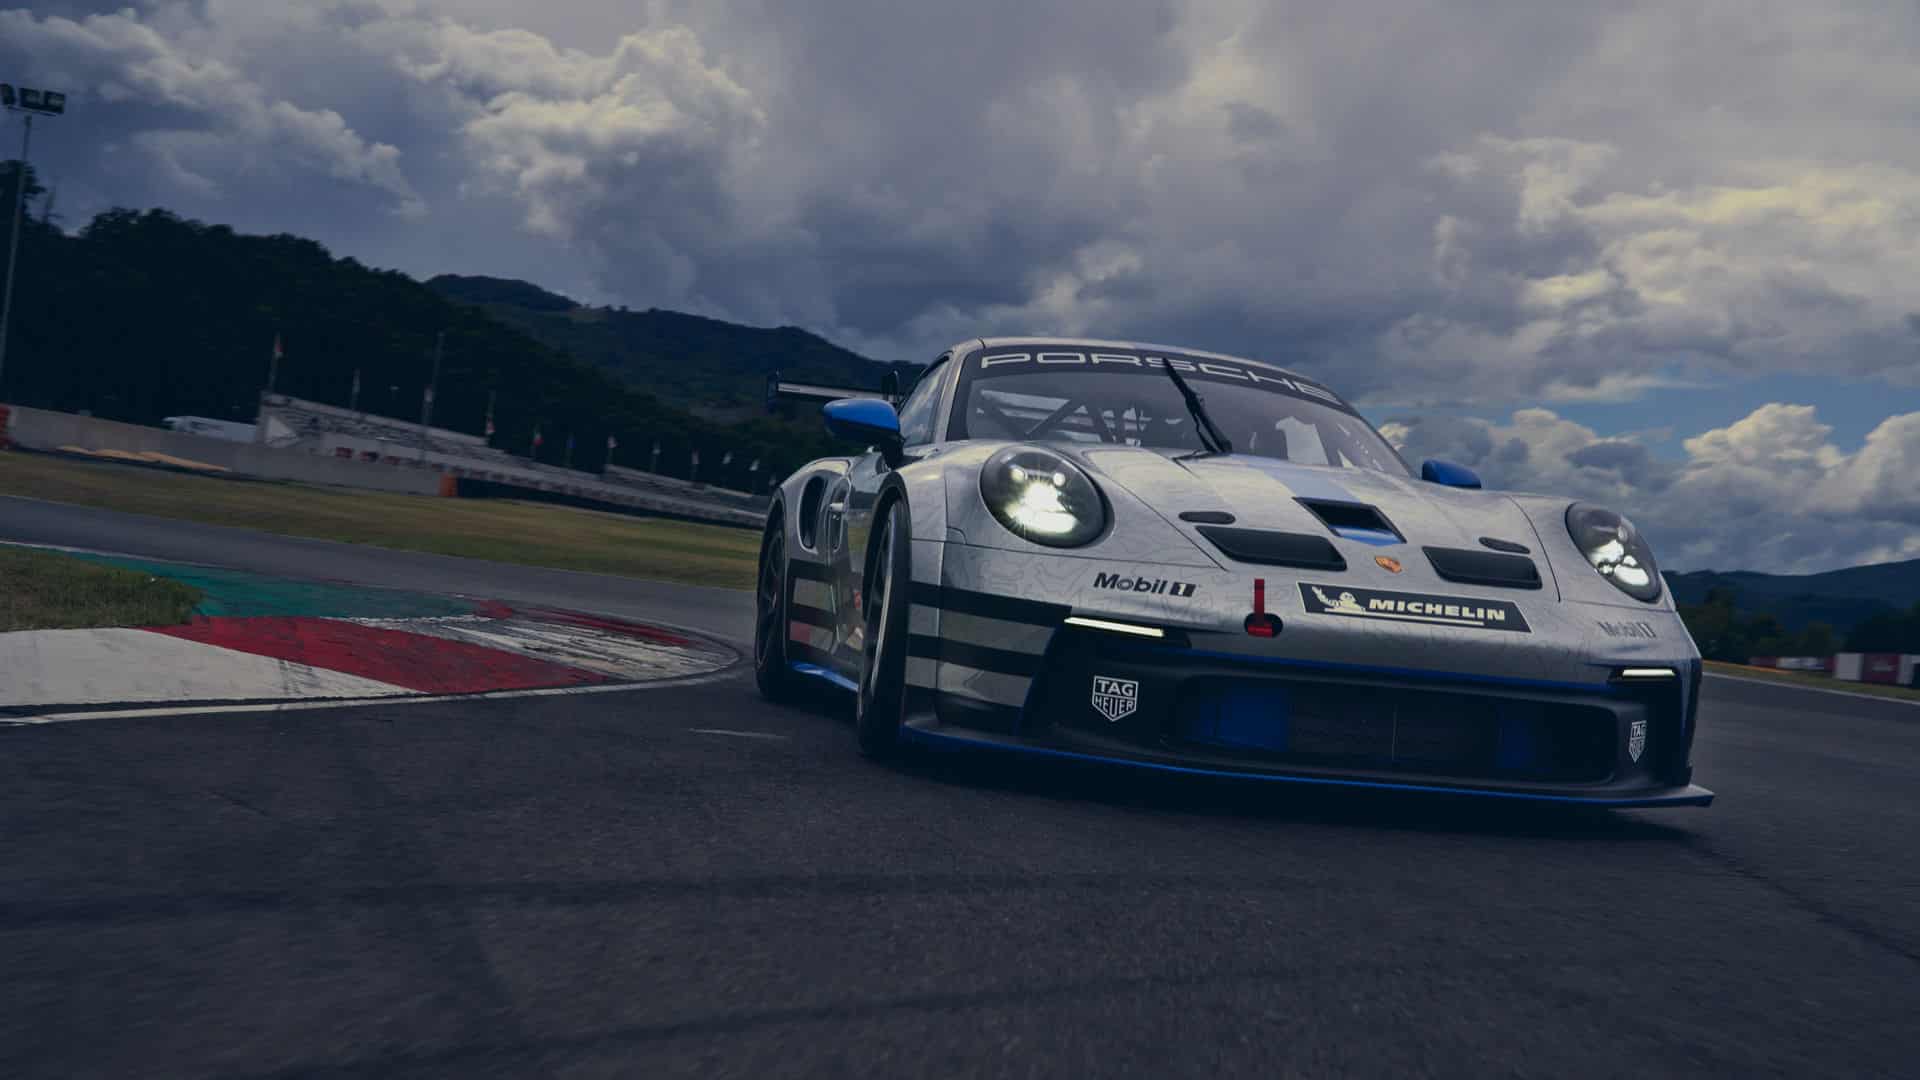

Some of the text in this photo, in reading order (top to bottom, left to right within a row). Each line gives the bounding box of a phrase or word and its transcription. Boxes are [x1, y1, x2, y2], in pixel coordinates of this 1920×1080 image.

[980, 352, 1342, 406] PORSCHE
[1093, 572, 1168, 595] Mobil
[1369, 598, 1506, 621] MICHELIN
[1097, 680, 1135, 697] TAG
[1095, 696, 1134, 717] HEUER
